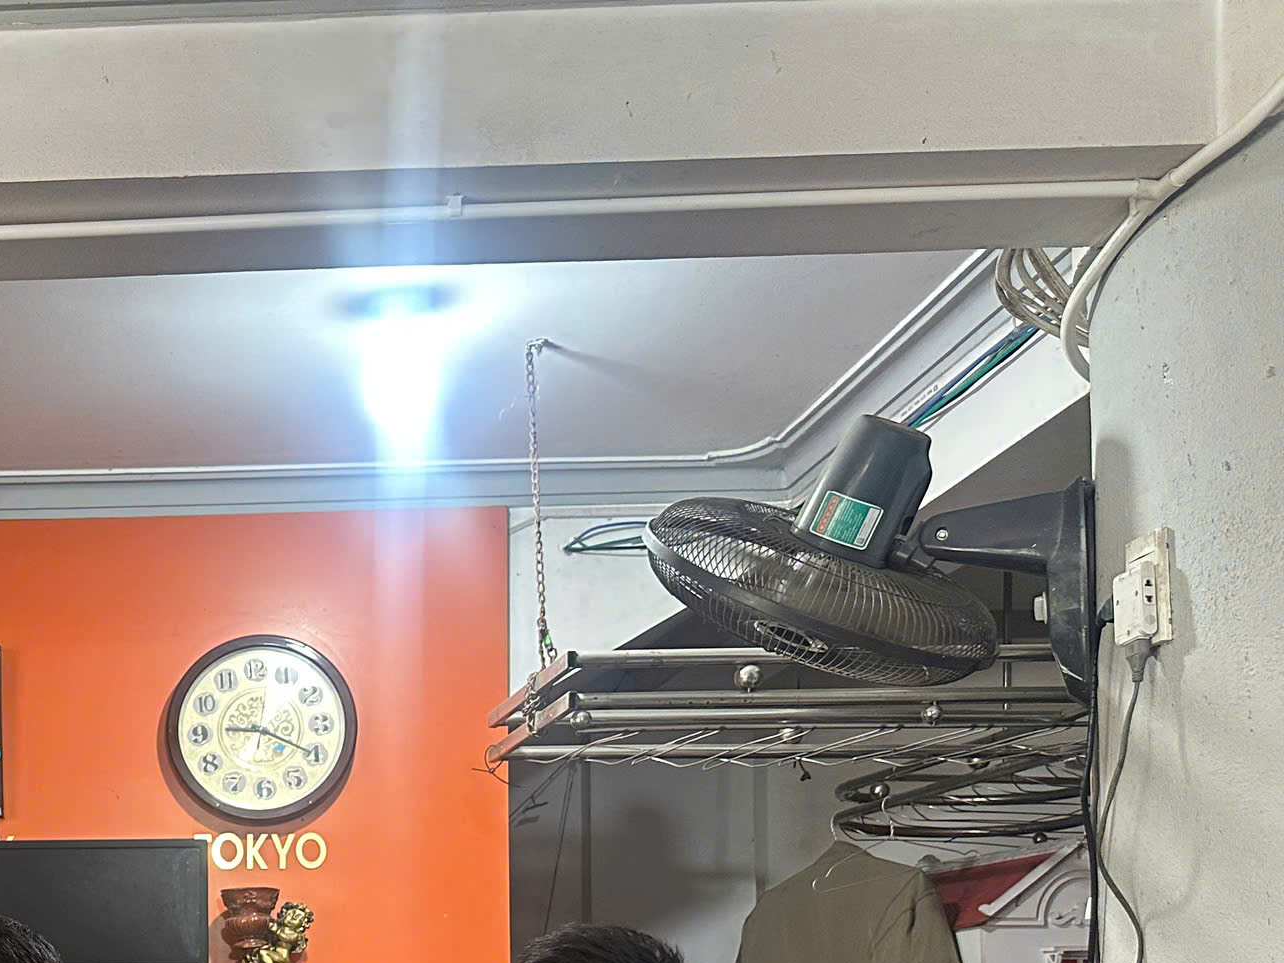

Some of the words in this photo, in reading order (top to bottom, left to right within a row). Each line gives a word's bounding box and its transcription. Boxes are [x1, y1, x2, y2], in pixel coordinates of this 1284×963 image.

[247, 661, 265, 679] 12
[283, 667, 291, 683] 1
[218, 672, 233, 688] 11
[198, 695, 215, 713] 10
[303, 687, 320, 704] 2
[315, 715, 331, 733] 3
[192, 727, 208, 744] 9
[203, 754, 218, 772] 8
[307, 746, 321, 764] 4
[226, 775, 244, 791] 7
[288, 770, 303, 787] 5
[258, 779, 273, 797] 6
